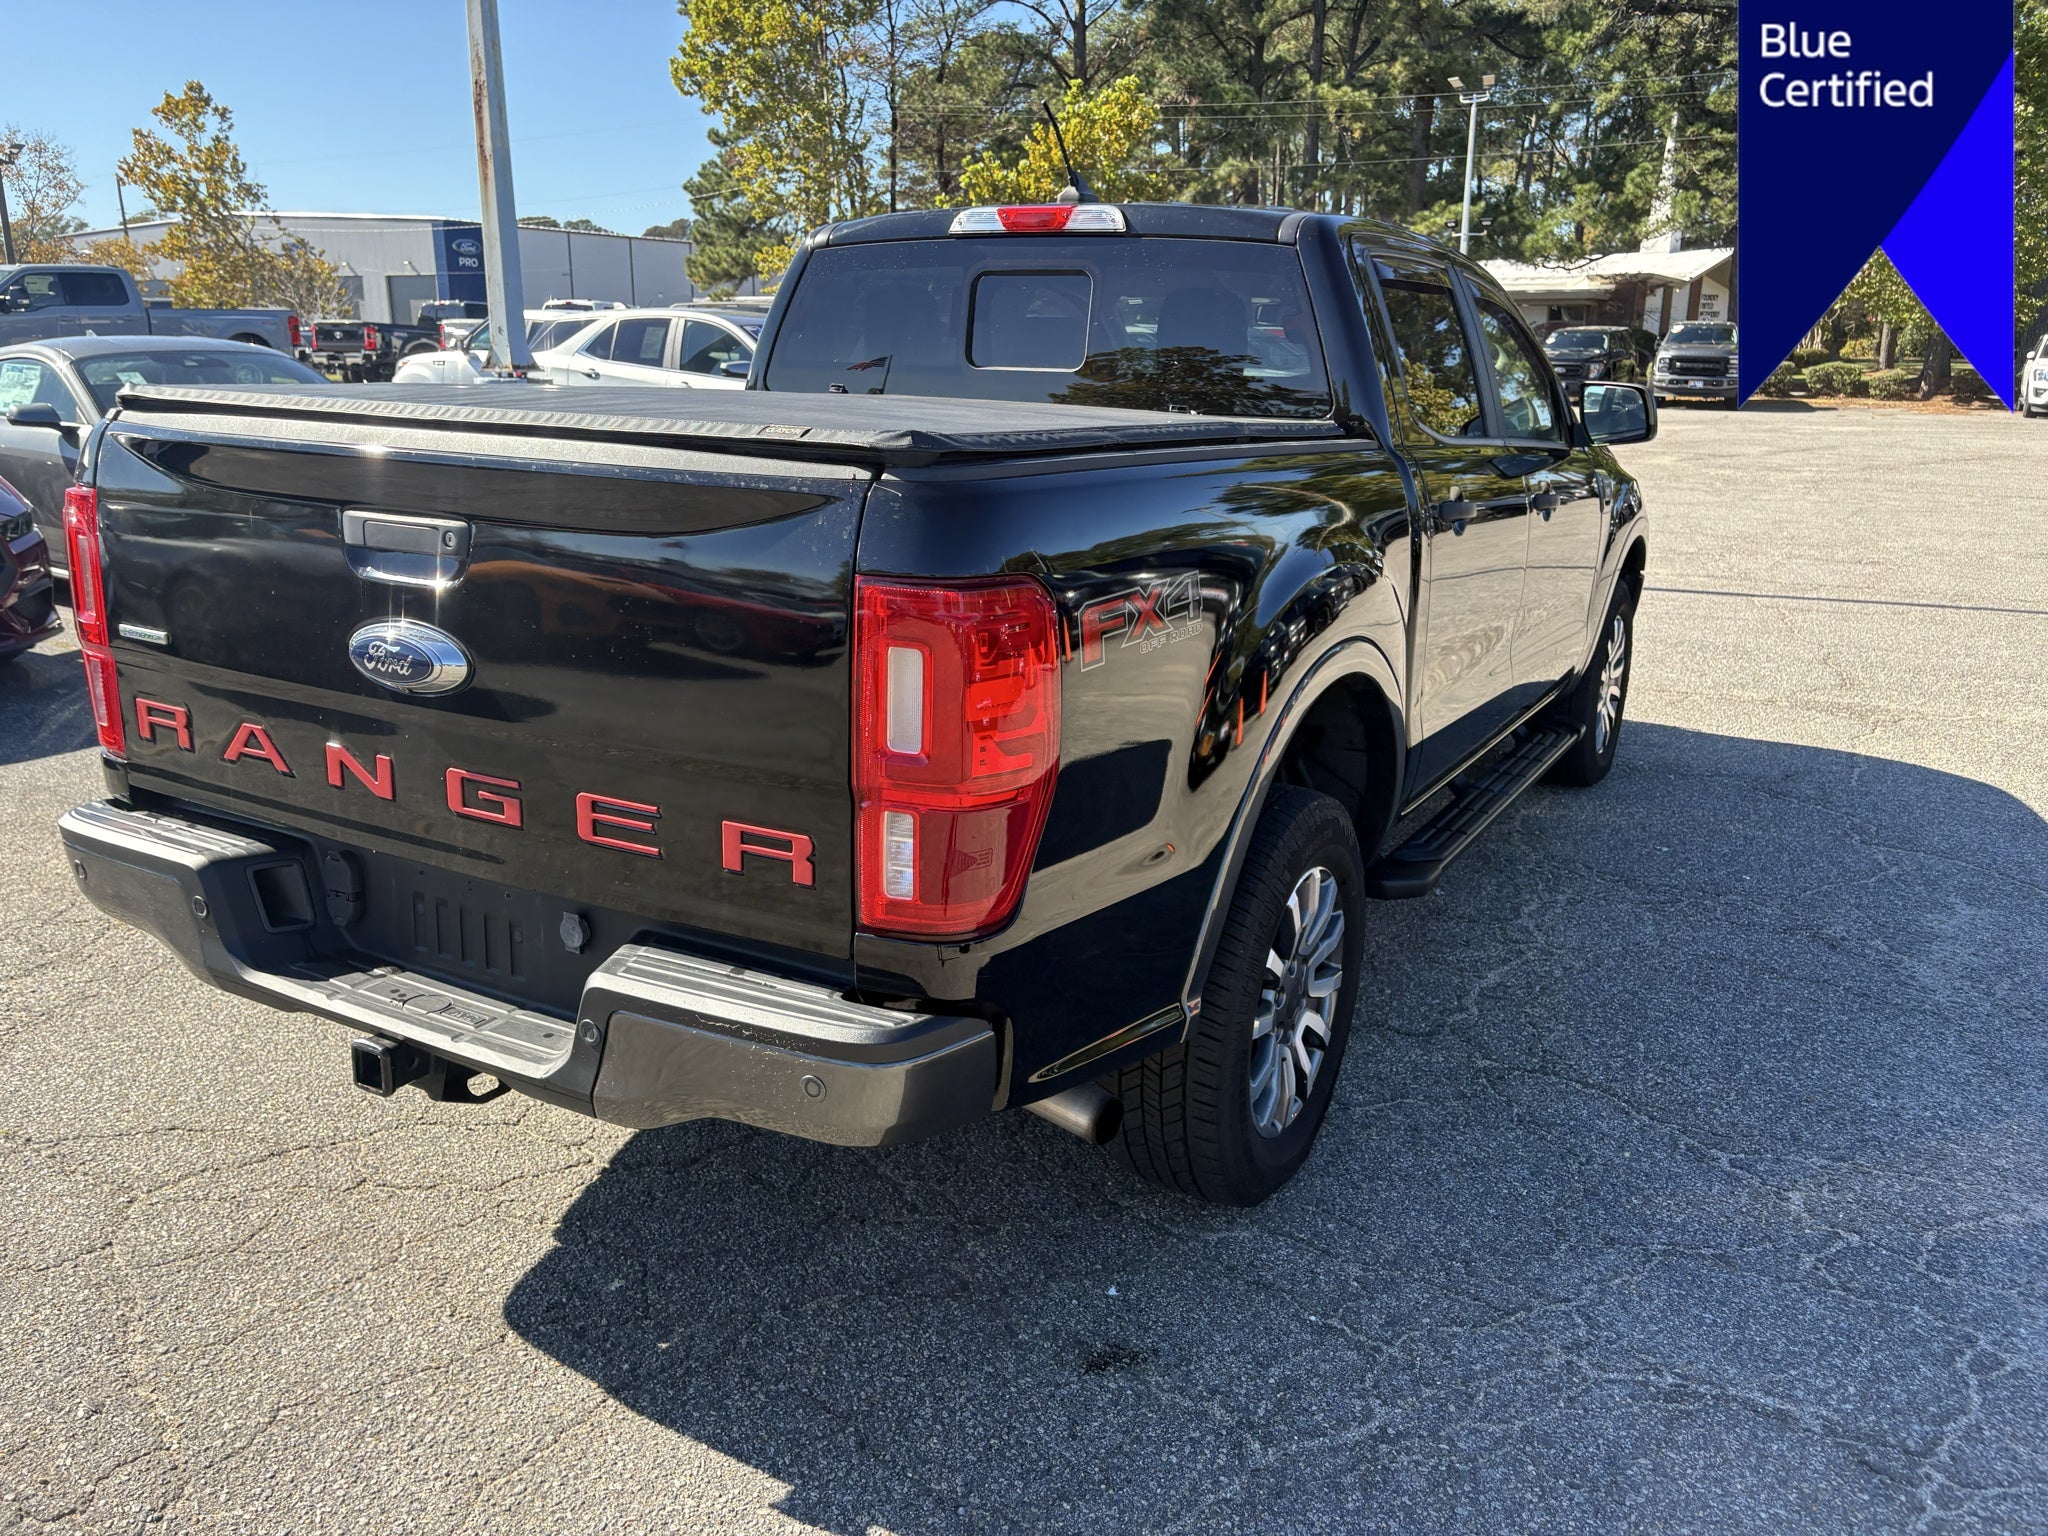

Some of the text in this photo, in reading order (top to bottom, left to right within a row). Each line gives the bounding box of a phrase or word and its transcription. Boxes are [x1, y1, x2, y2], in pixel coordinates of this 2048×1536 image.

[459, 257, 478, 267] PRO
[1078, 569, 1202, 672] FX4
[1139, 622, 1203, 655] OFF ROAD
[135, 697, 815, 888] RANGER
